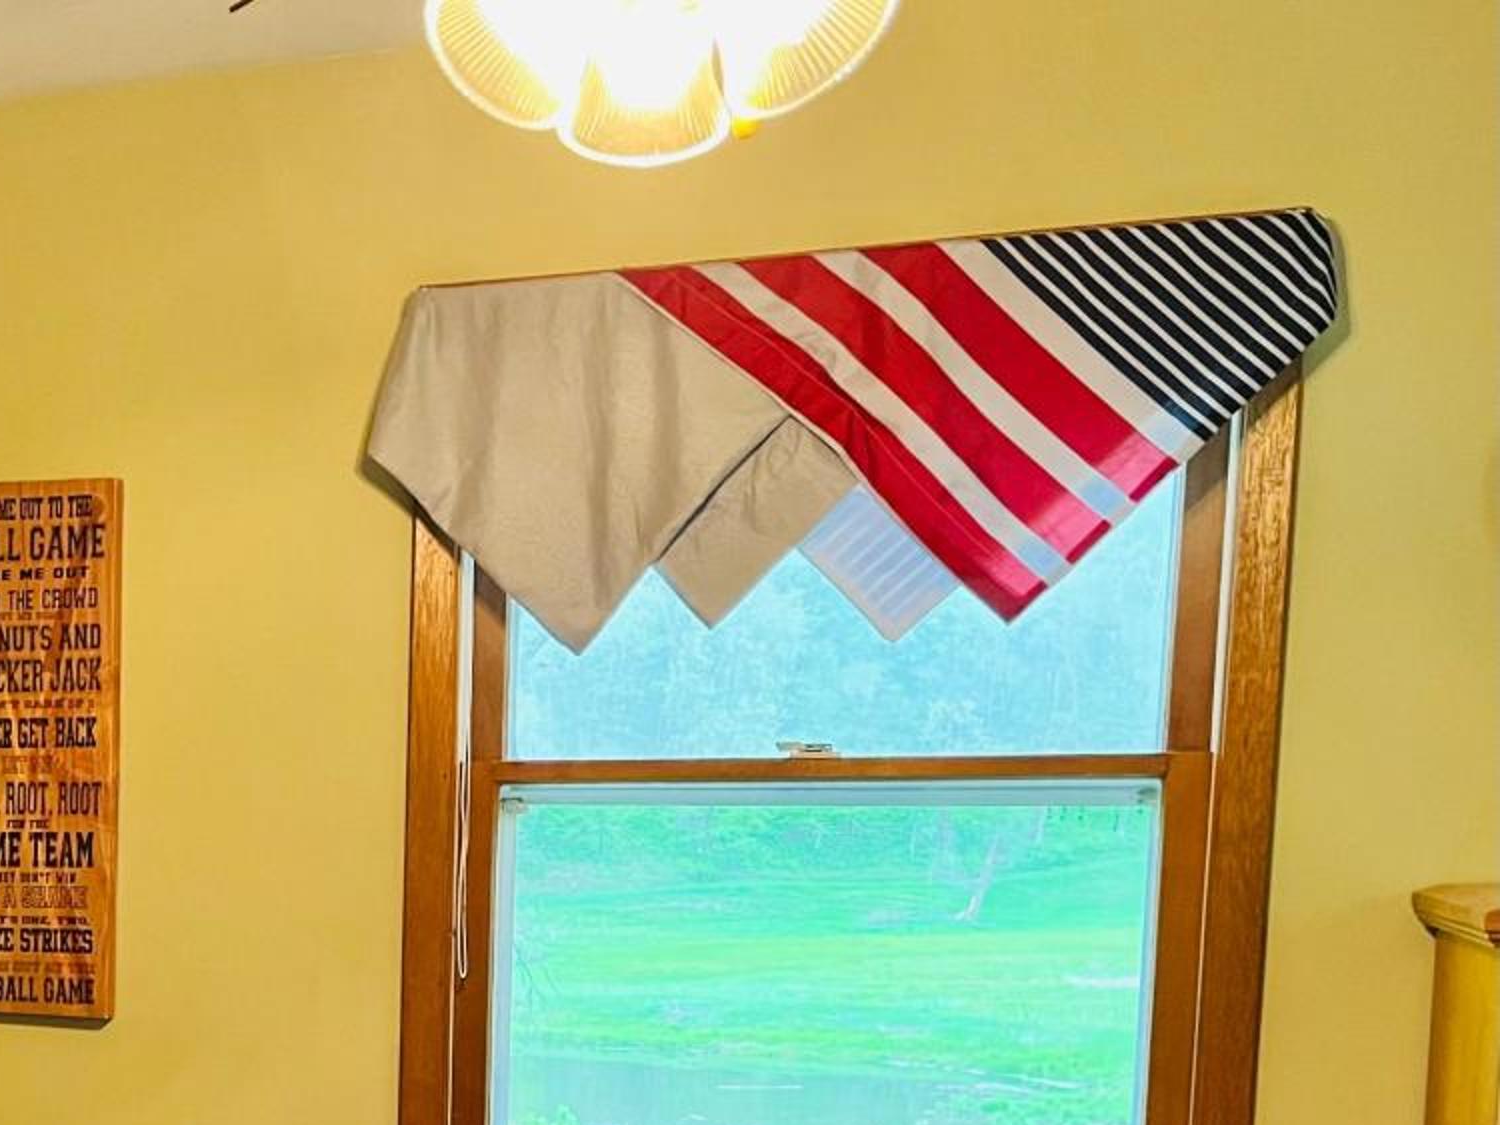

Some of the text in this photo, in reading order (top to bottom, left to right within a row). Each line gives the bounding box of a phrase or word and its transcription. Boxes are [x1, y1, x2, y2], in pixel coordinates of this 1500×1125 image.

[19, 497, 43, 520] OUT
[47, 495, 63, 518] TO
[67, 494, 93, 518] THE
[29, 523, 106, 561] GAME
[19, 568, 45, 581] ME
[53, 566, 89, 579] OUT
[7, 589, 35, 611] THE
[41, 586, 98, 610] CROWD
[59, 623, 101, 650] AND
[50, 655, 102, 692] JACK
[17, 717, 50, 747] GET
[55, 716, 98, 747] BACK
[58, 781, 102, 817] ROOT
[29, 831, 95, 869] TEAM
[20, 927, 94, 955] STRIKES
[43, 976, 96, 1005] GAME
